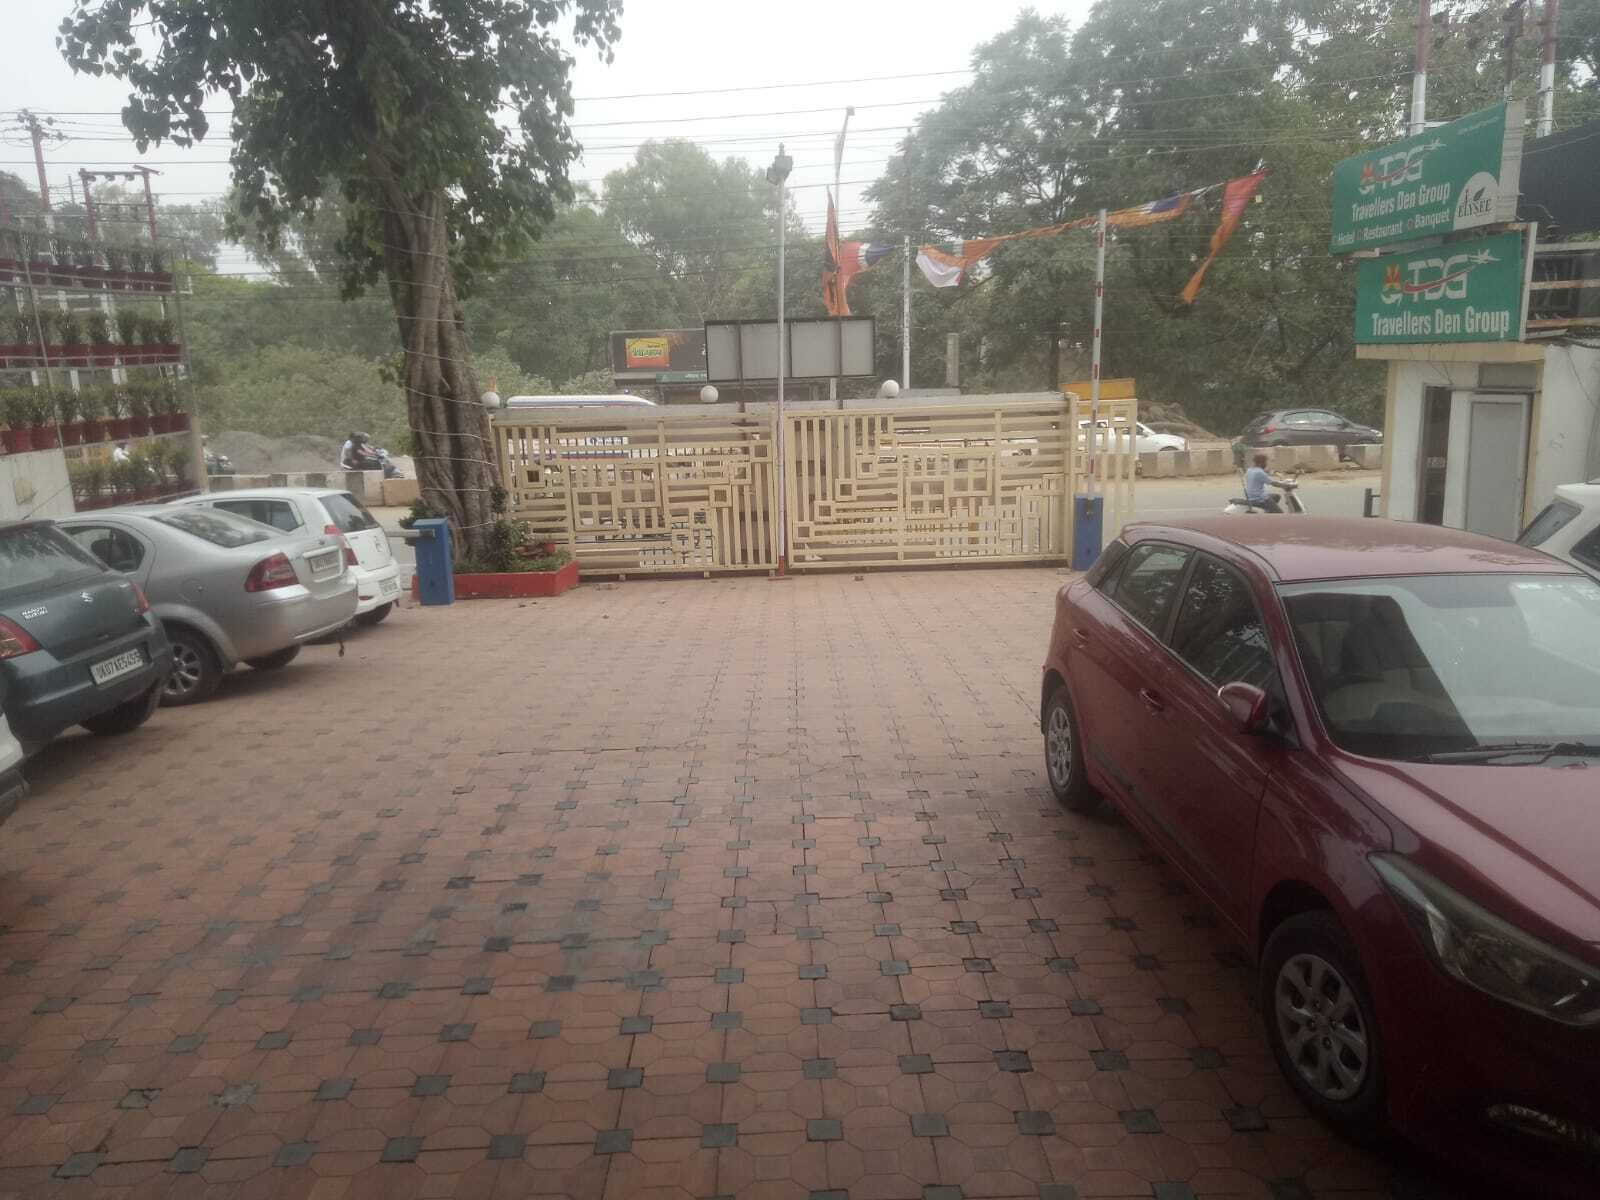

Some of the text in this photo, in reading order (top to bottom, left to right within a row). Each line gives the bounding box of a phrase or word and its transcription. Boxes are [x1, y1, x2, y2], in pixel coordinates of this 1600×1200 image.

[1380, 145, 1424, 189] TDG
[1352, 182, 1450, 222] Travellers Den Group
[1363, 222, 1402, 241] Restaurant
[1415, 210, 1450, 230] Banquet
[1408, 254, 1468, 302] TDG
[1372, 307, 1509, 338] Travellers Den Group
